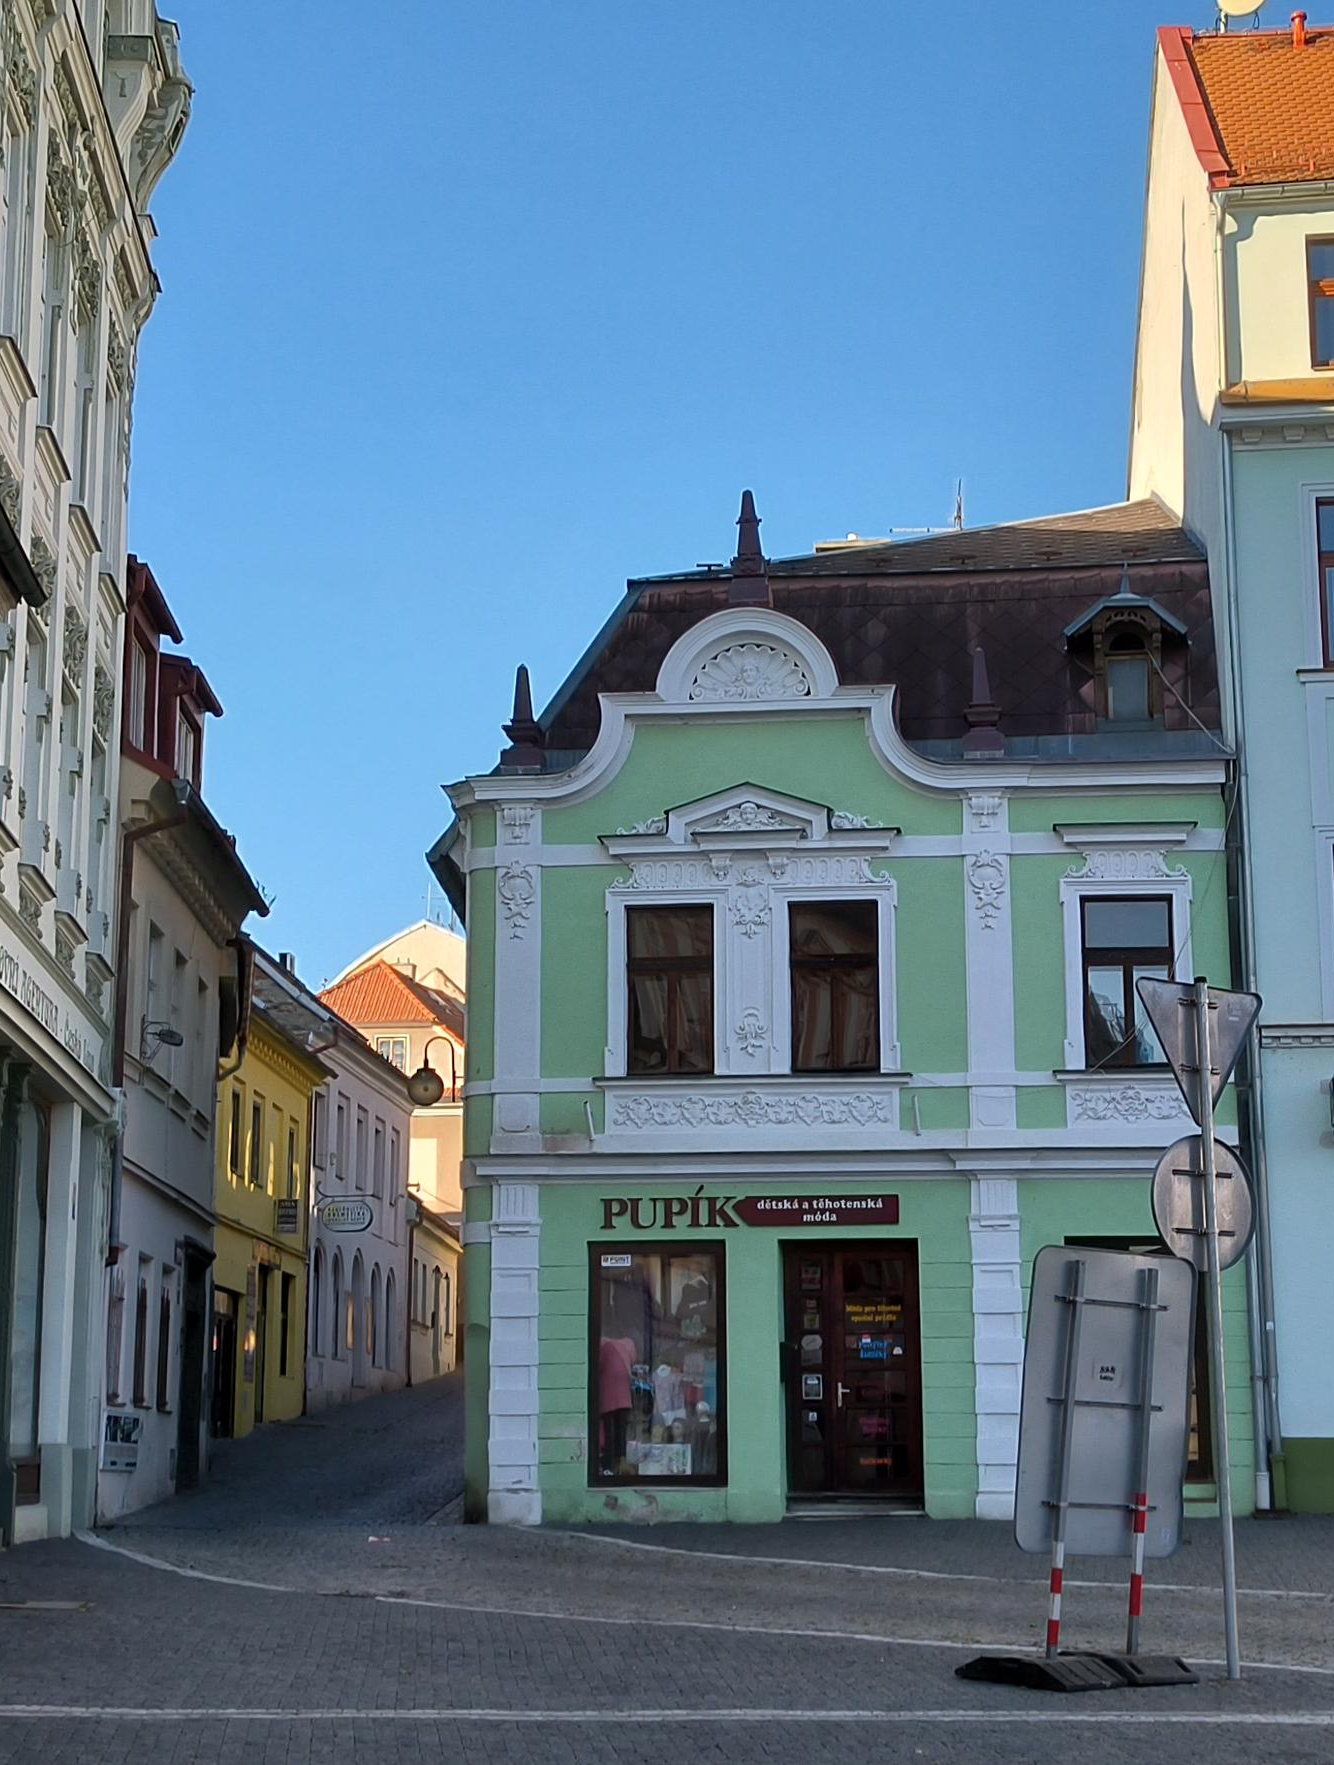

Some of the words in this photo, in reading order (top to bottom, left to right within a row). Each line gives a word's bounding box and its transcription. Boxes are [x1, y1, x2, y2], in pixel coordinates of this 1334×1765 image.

[600, 1184, 740, 1229] PUPÍK
[757, 1199, 799, 1210] dětská
[802, 1202, 809, 1210] a
[812, 1198, 883, 1209] těhotenská
[803, 1211, 837, 1222] móda
